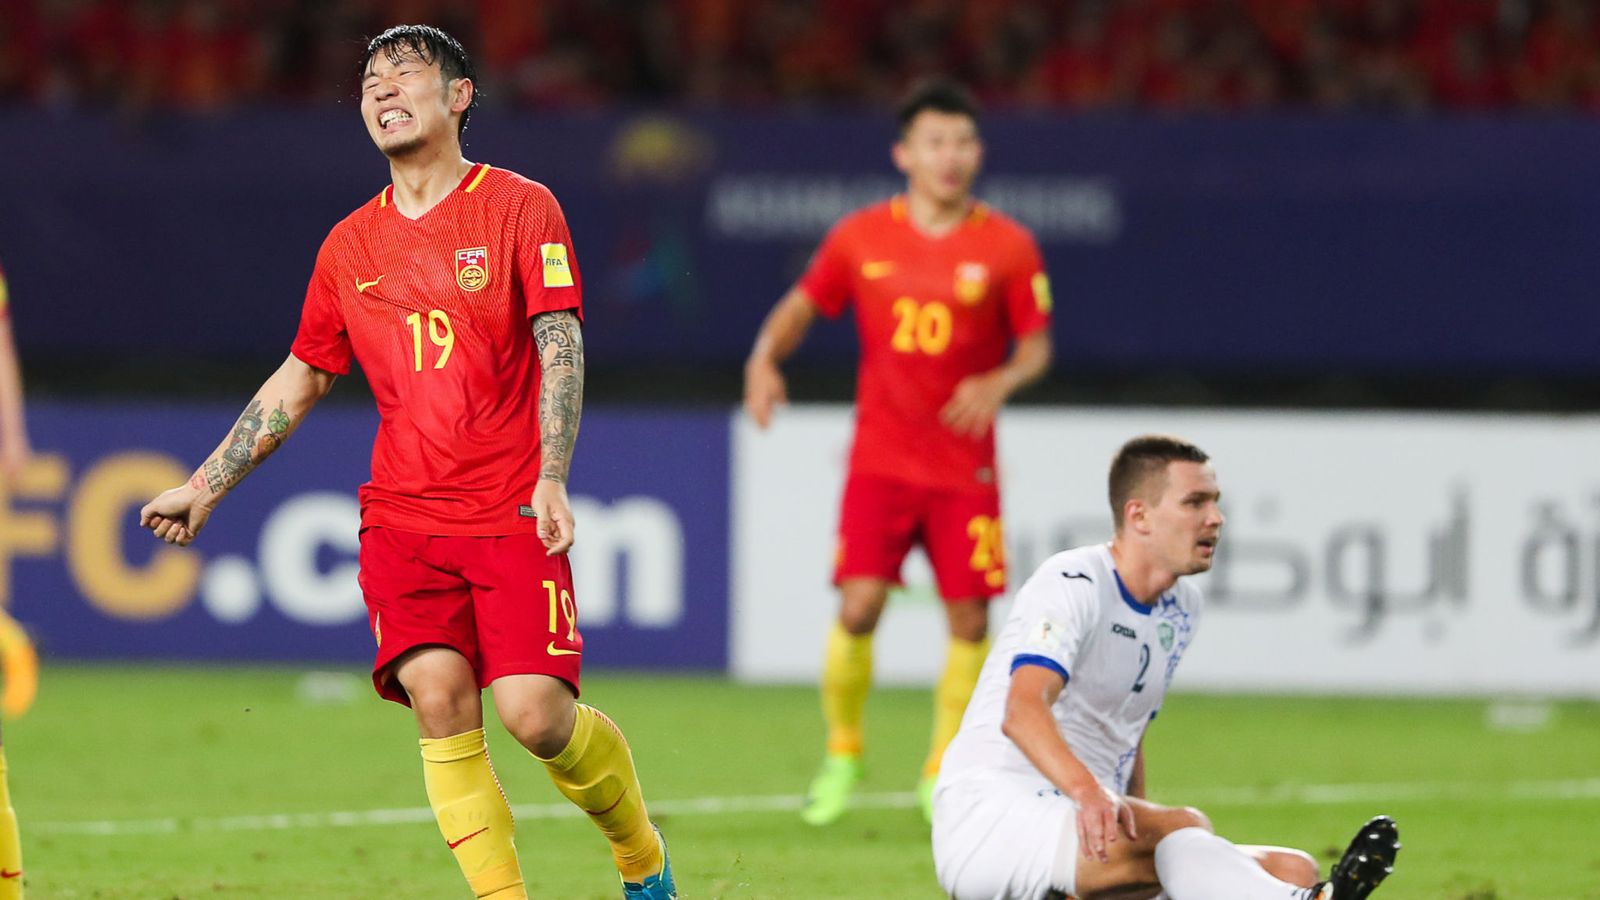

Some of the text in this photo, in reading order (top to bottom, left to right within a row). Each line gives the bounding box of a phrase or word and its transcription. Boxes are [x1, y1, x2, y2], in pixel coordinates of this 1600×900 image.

[458, 249, 485, 260] CFA
[545, 257, 563, 267] FIFA
[406, 309, 455, 373] 19
[892, 296, 953, 356] 20
[542, 580, 576, 641] 19
[1131, 643, 1151, 694] 2
